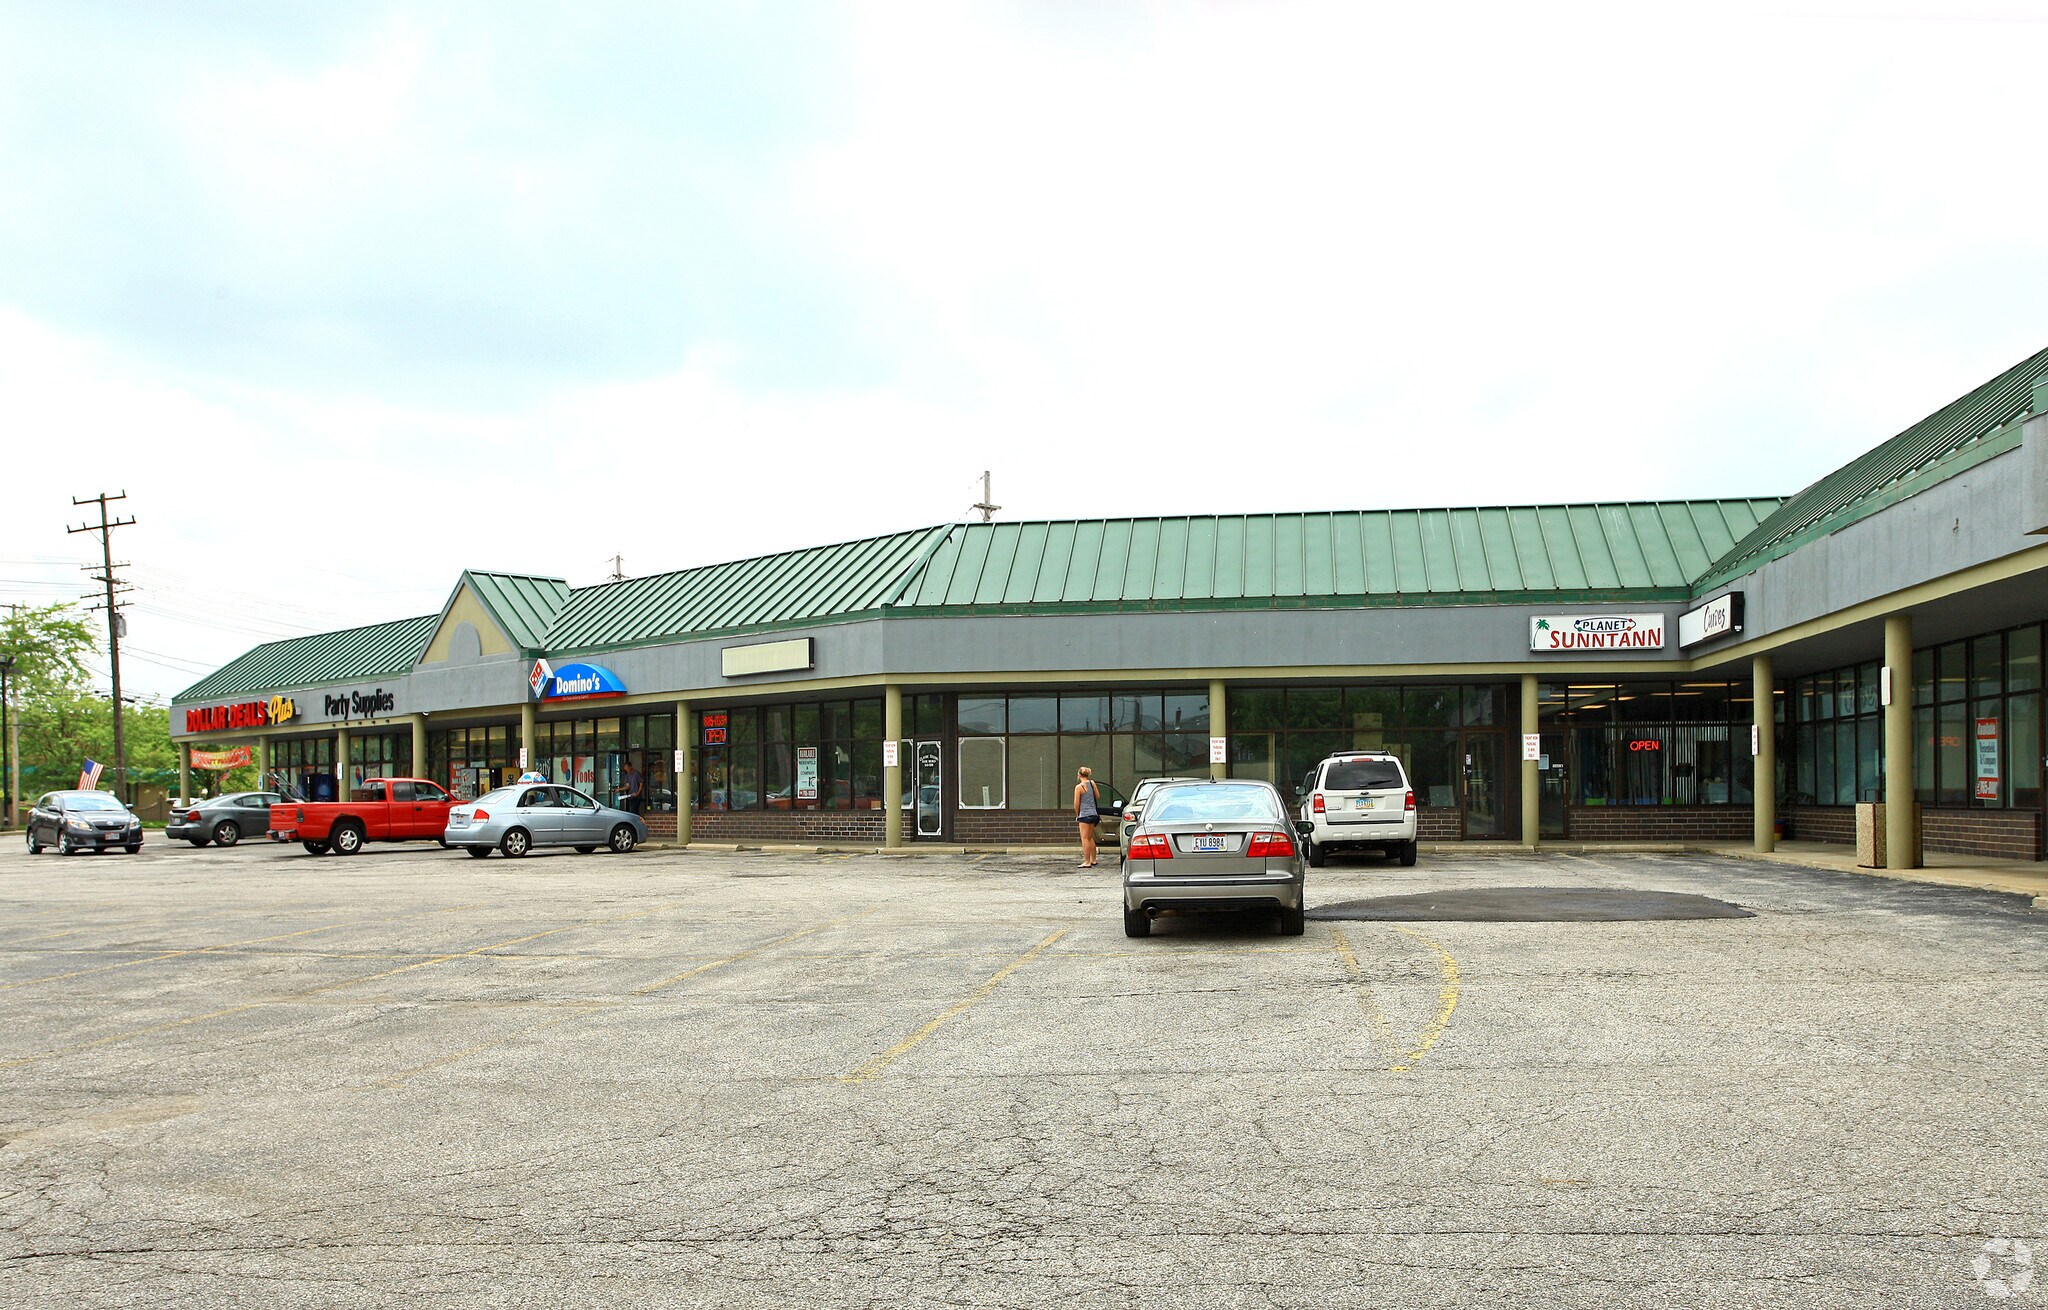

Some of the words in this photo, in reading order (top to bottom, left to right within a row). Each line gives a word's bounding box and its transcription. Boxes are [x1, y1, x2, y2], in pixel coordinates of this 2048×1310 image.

[1582, 620, 1628, 631] PLANET
[1550, 627, 1661, 649] SUNNTANN
[556, 672, 600, 694] Domino's
[186, 704, 229, 733] DOLLAR
[229, 700, 267, 729] DEALS
[268, 694, 294, 726] Plus
[325, 693, 350, 721] Party
[352, 688, 394, 719] Supplies
[706, 729, 727, 743] OPEN
[1630, 740, 1659, 751] OPEN
[575, 769, 595, 783] Tools
